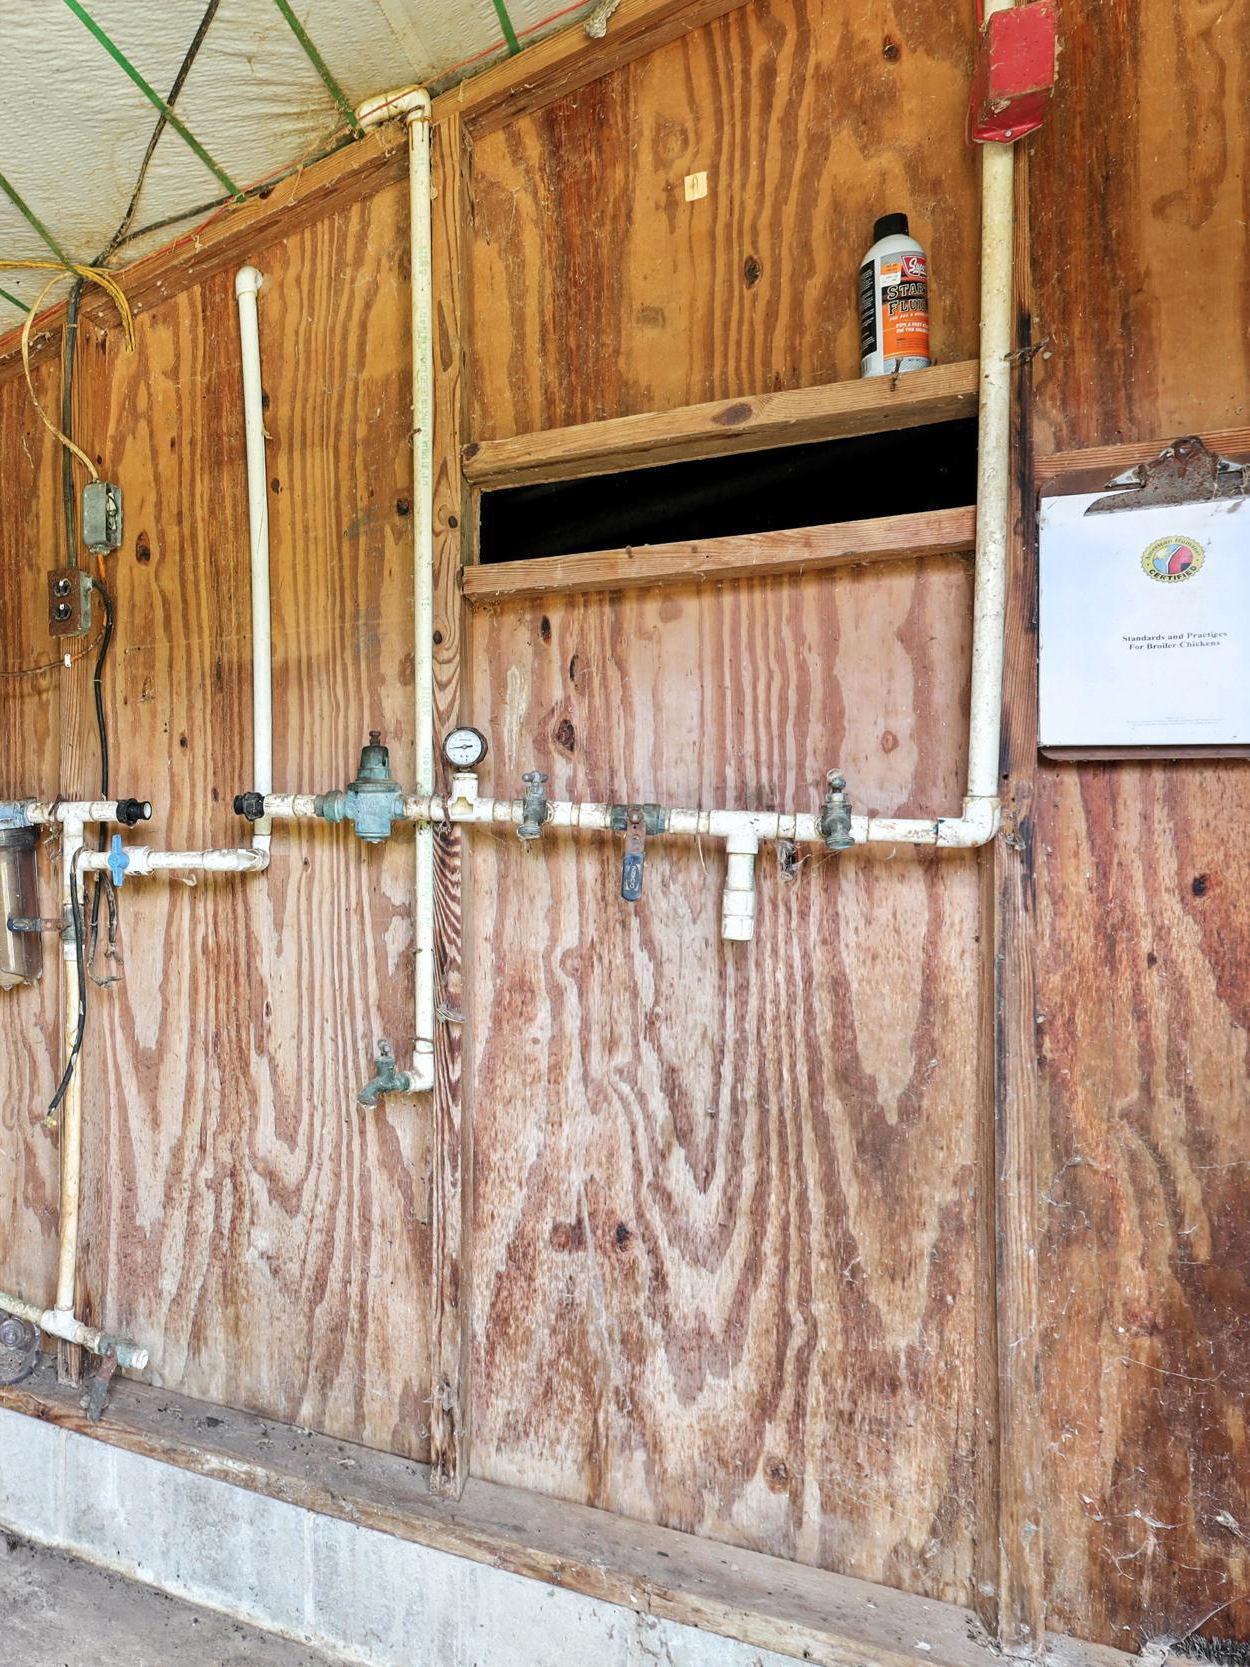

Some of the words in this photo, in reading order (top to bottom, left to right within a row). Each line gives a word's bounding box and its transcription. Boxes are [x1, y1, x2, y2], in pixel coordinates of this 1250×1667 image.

[1145, 539, 1172, 559] American
[1149, 565, 1197, 581] CERTIFIED
[1122, 634, 1165, 642] Standards
[1146, 642, 1176, 650] Broiler
[1179, 640, 1220, 648] Chickens
